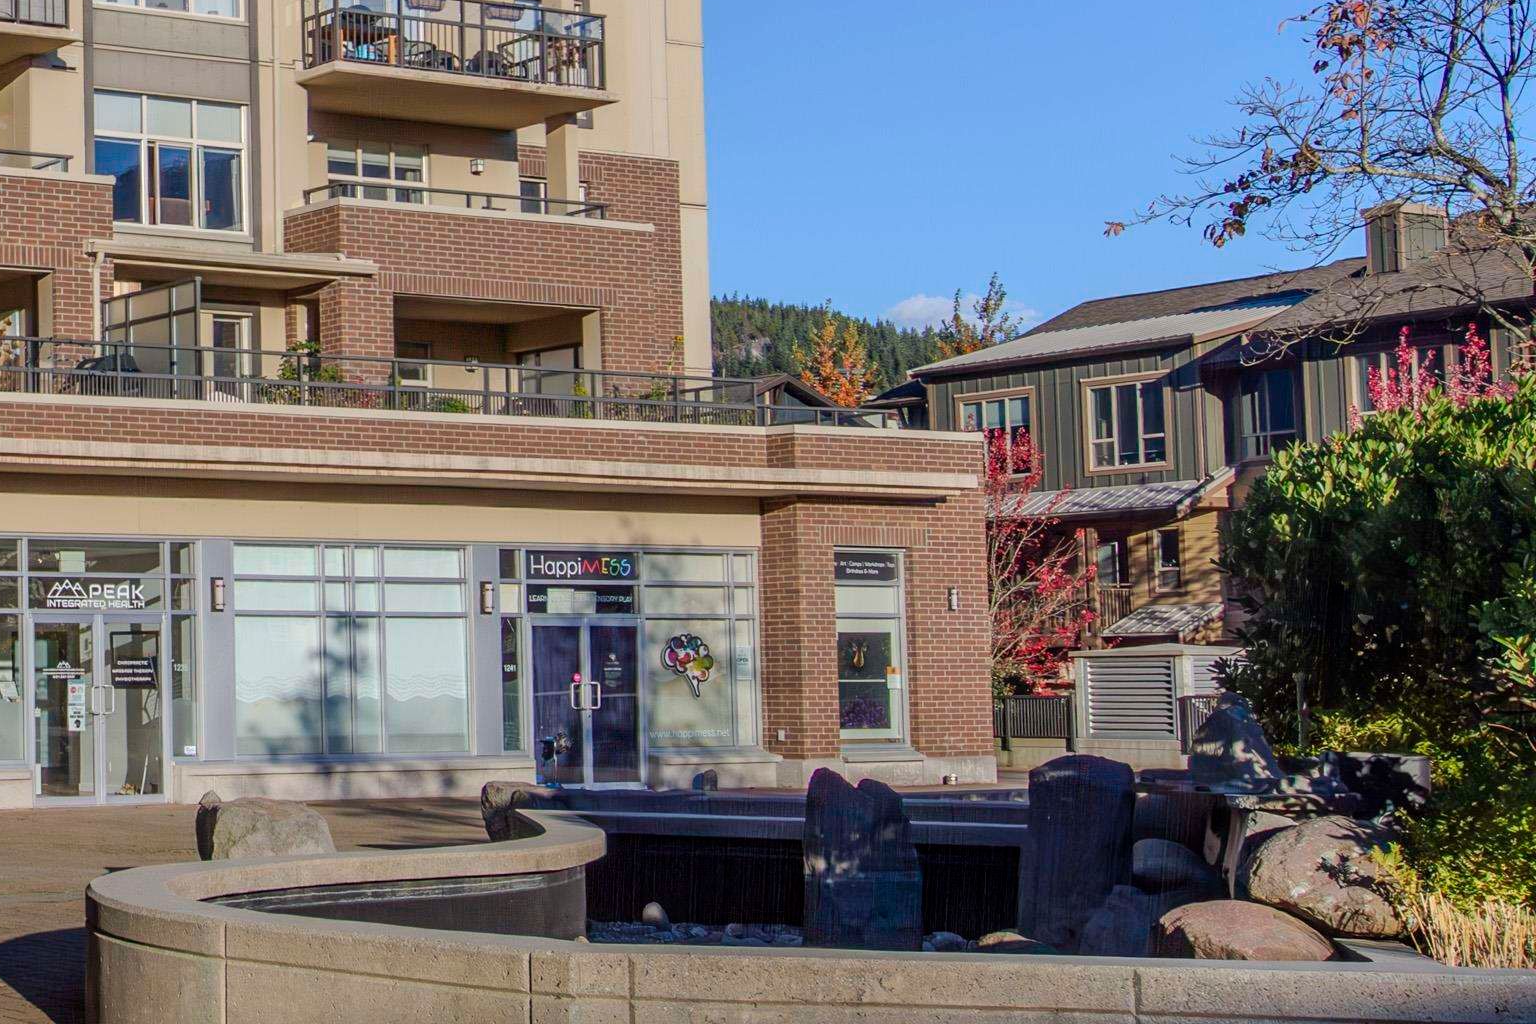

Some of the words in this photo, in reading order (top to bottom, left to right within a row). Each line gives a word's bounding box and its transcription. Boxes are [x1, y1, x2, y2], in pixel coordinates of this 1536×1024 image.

[530, 555, 632, 578] HappiMESS
[89, 584, 145, 599] PEAK
[47, 599, 107, 608] INTEGRATED
[108, 600, 145, 608] HEALTH
